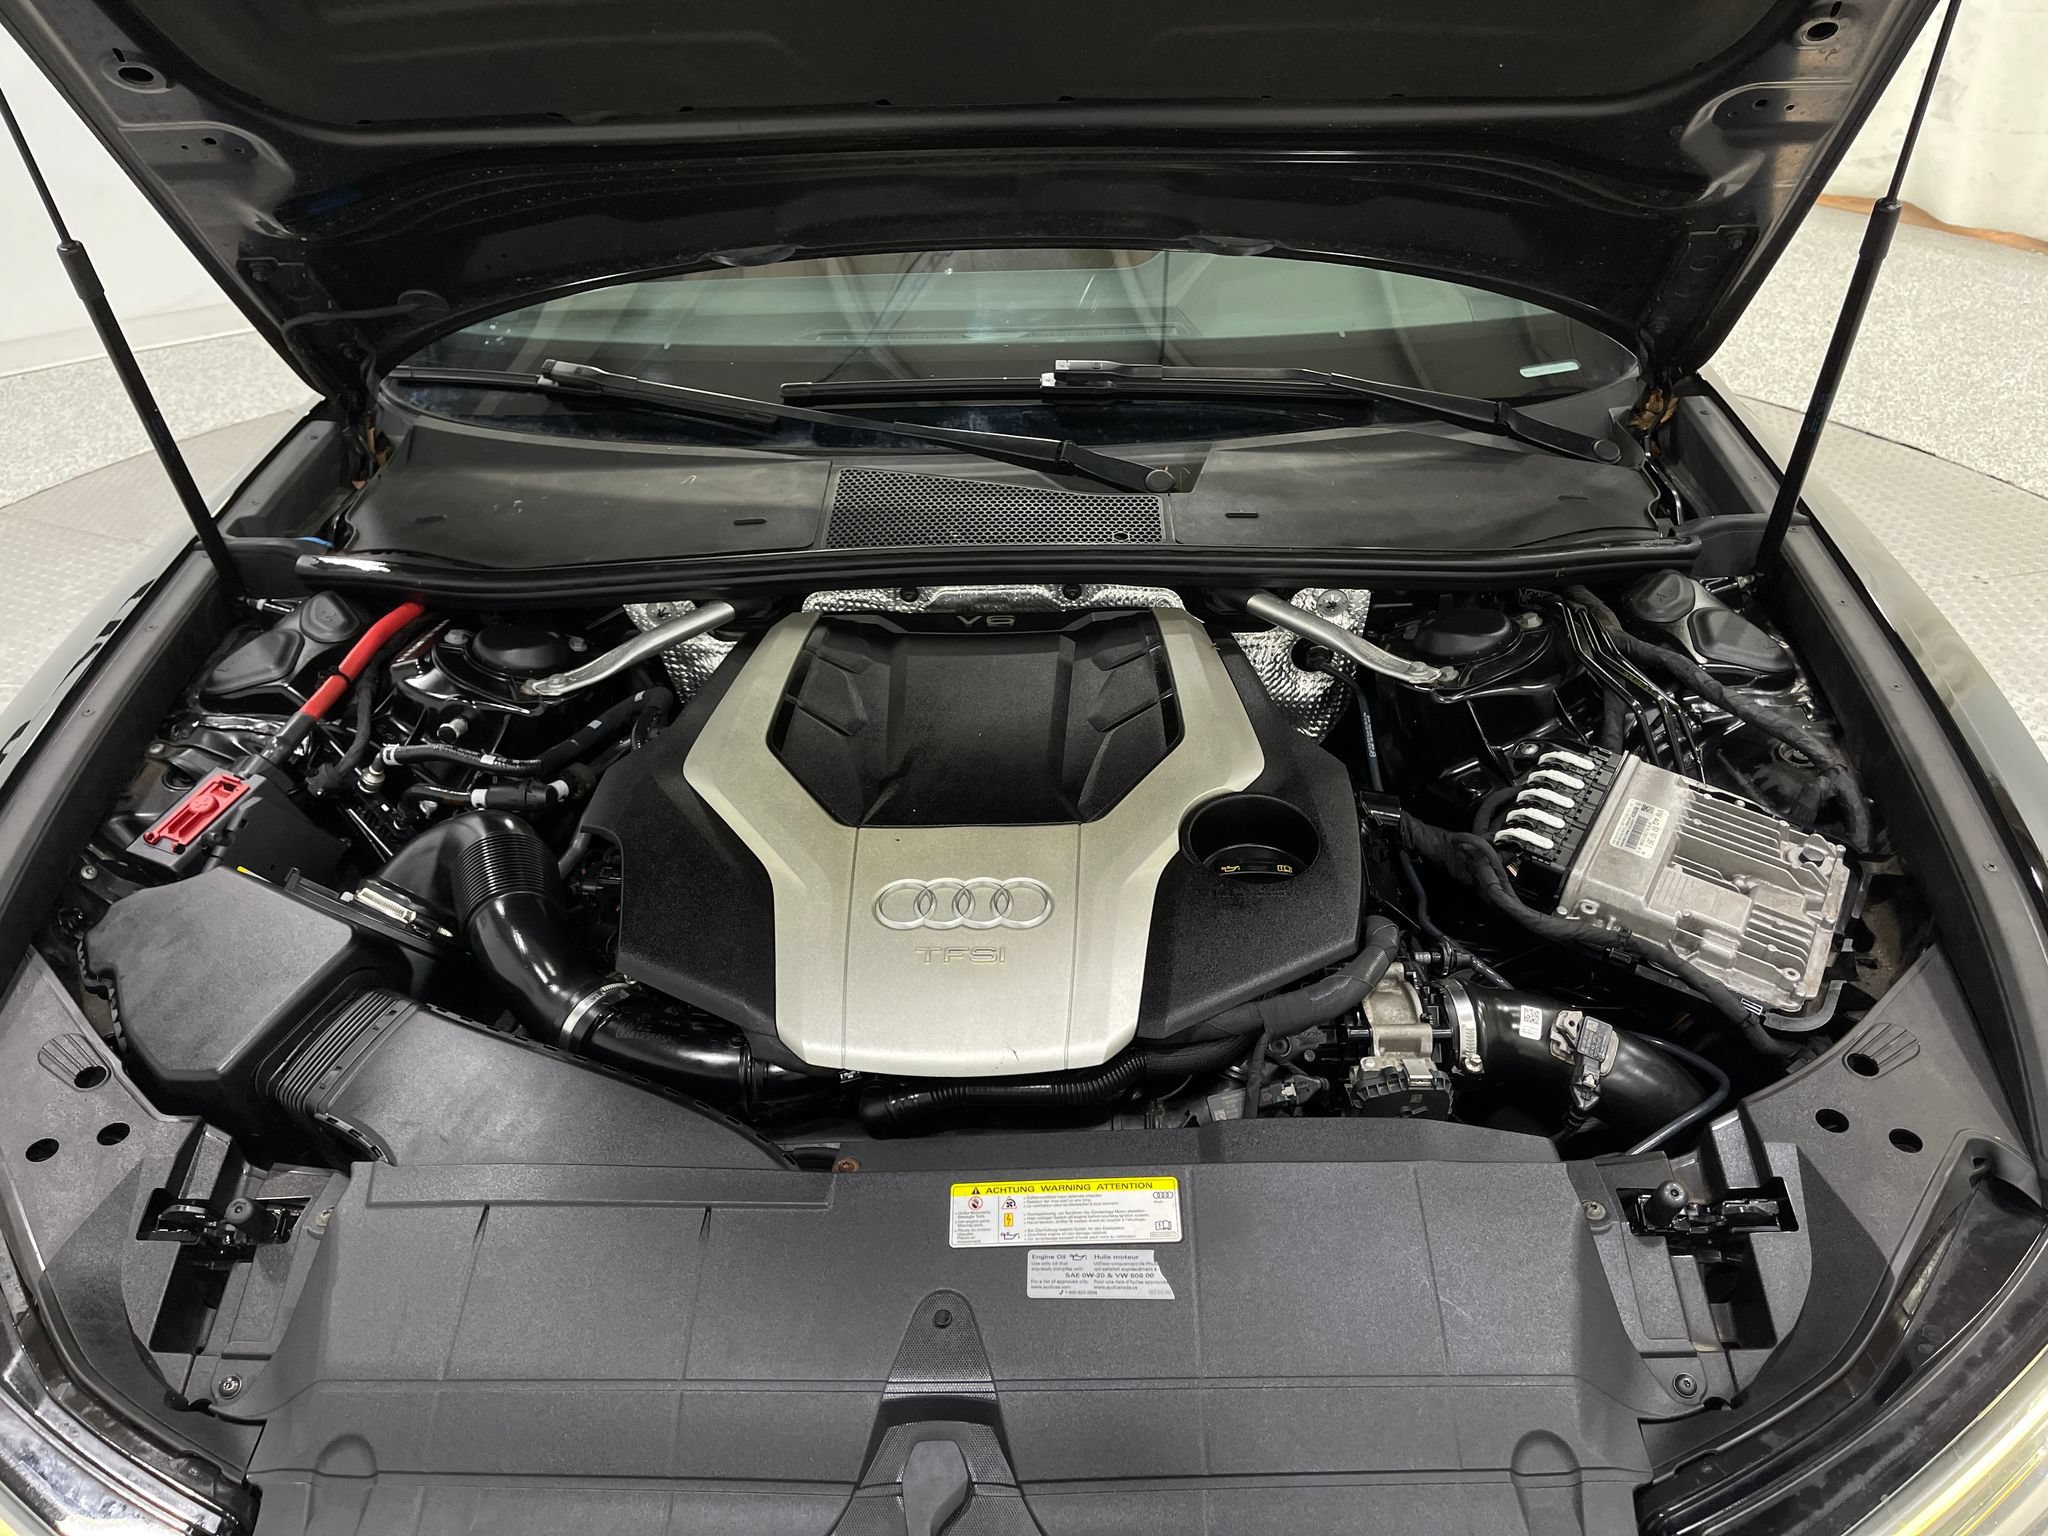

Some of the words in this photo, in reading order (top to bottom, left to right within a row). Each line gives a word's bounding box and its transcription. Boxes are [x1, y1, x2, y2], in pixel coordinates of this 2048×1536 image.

[956, 615, 1015, 627] V6
[915, 946, 1005, 963] TFSI
[986, 1186, 1035, 1194] ACHTUNG
[1041, 1184, 1091, 1192] WARNING
[1096, 1182, 1153, 1190] ATTENTION
